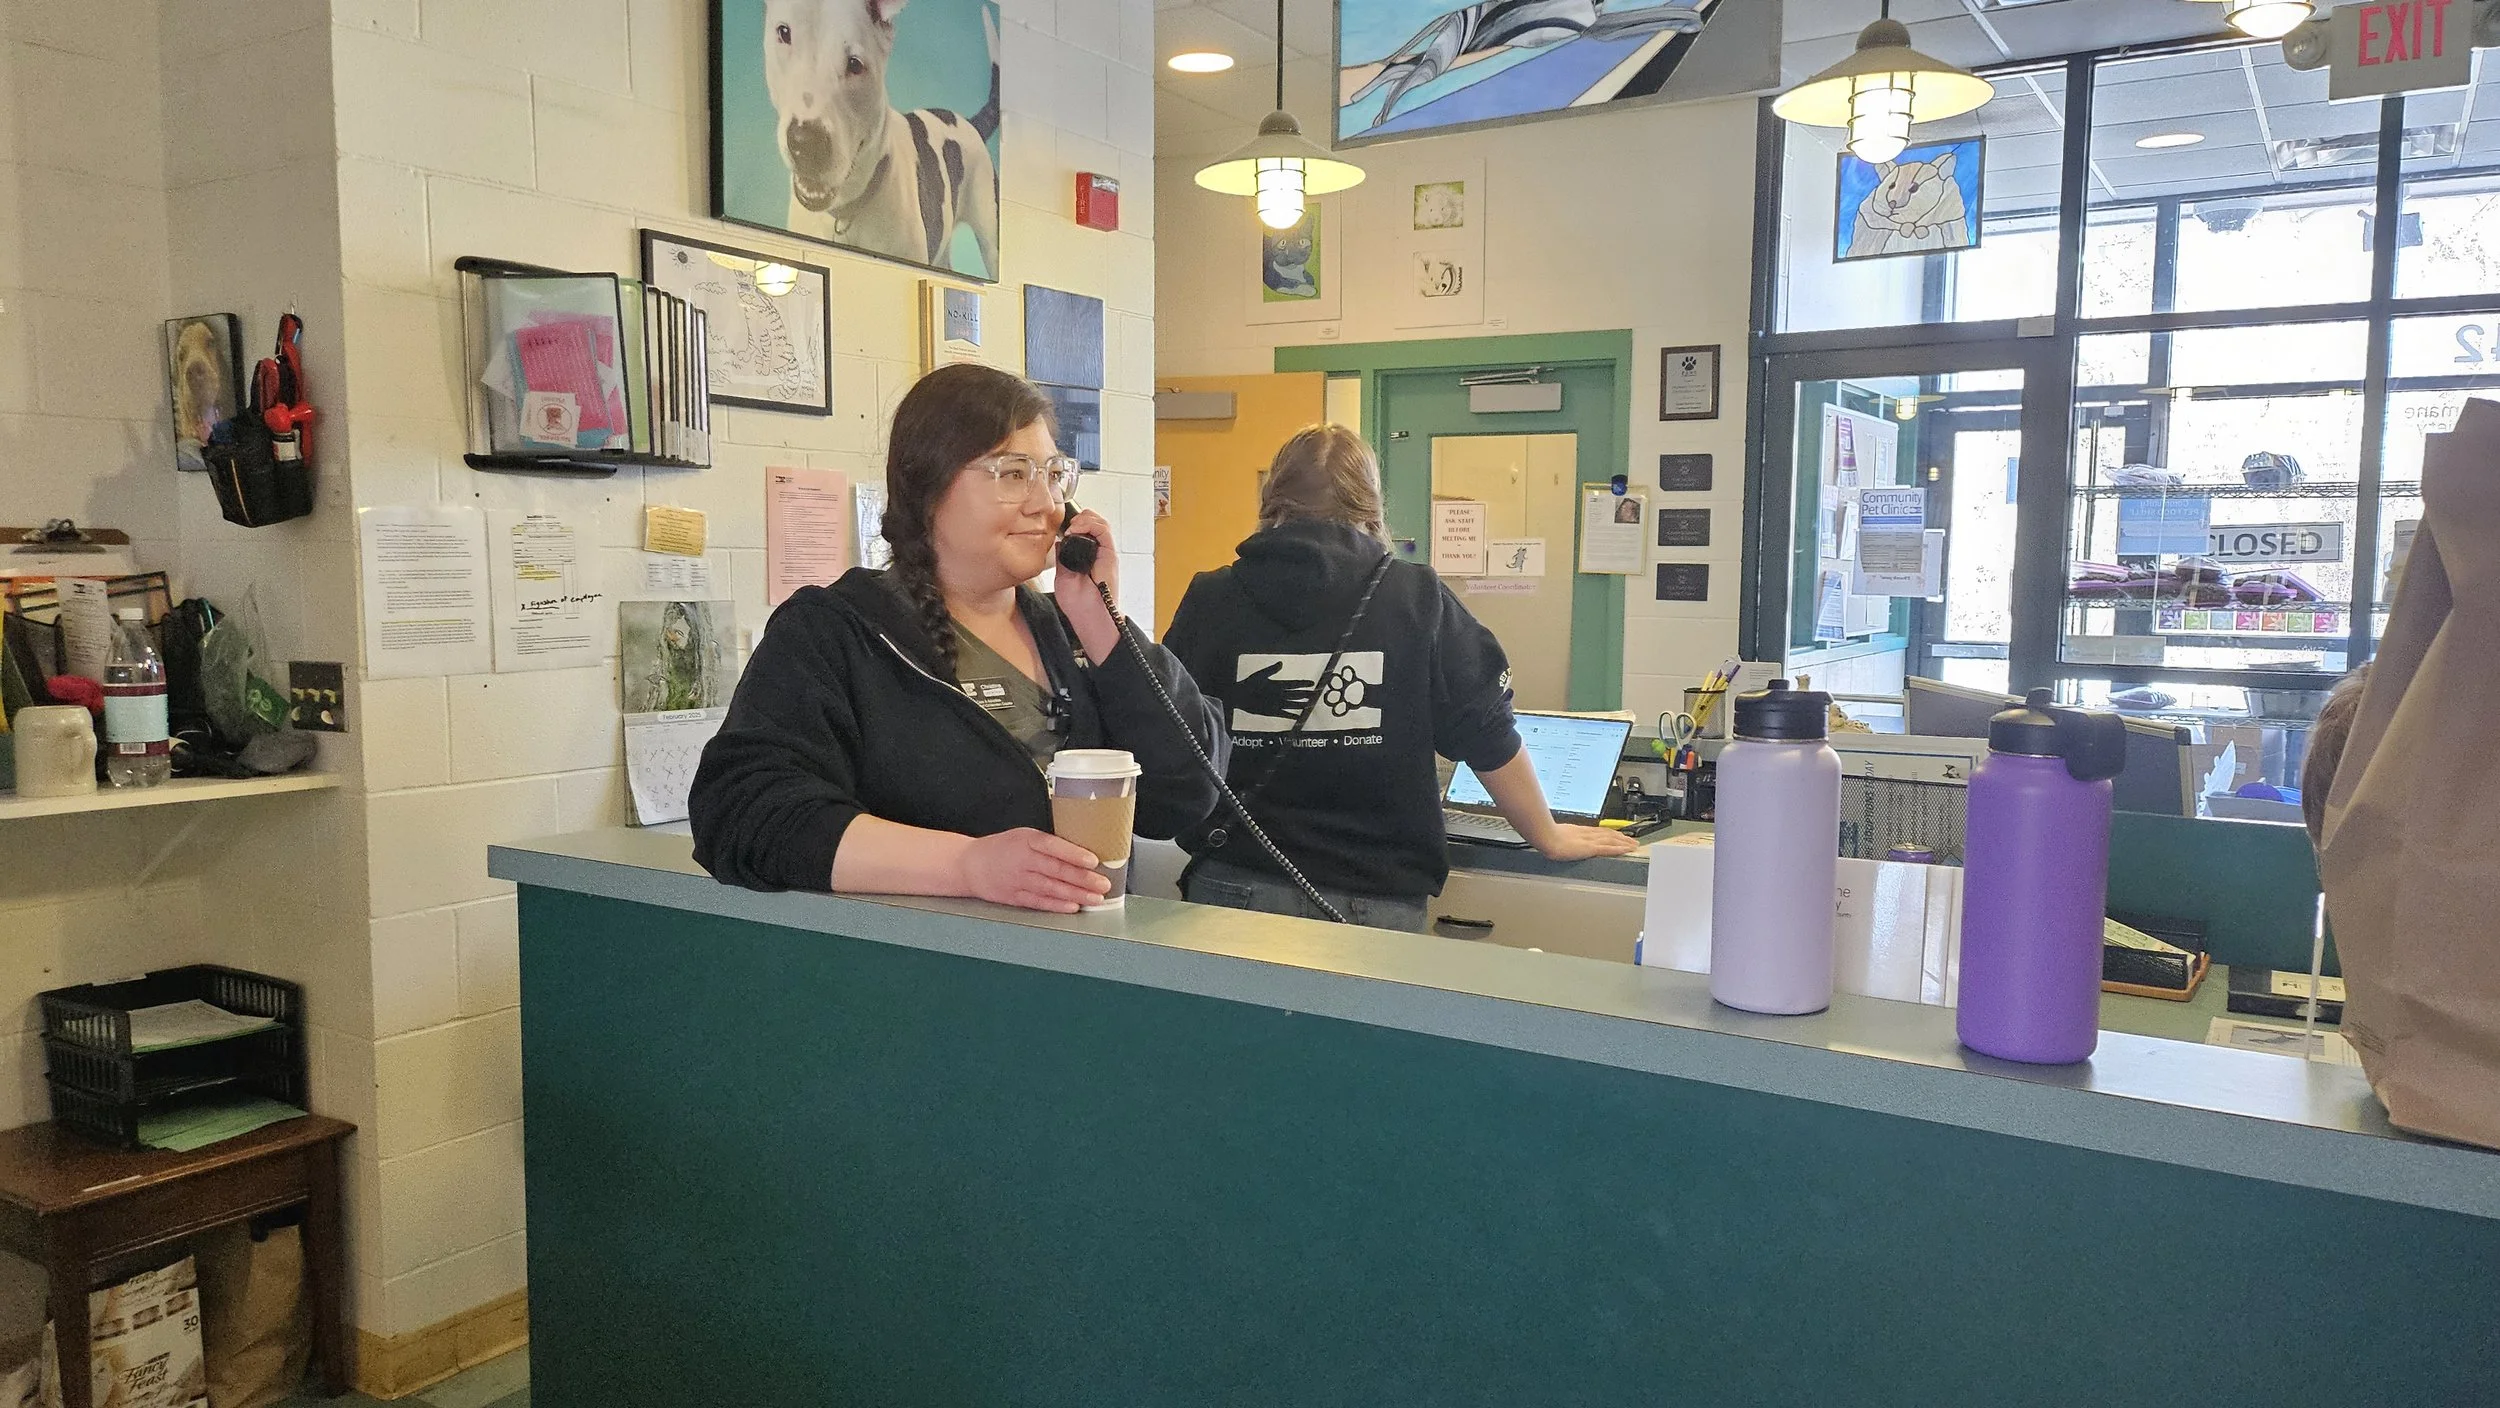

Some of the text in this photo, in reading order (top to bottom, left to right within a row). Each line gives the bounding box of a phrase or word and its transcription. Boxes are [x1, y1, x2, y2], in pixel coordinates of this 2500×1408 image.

[2358, 0, 2453, 67] EXIT
[947, 307, 978, 322] NO-KILL
[1862, 491, 1922, 505] Community
[1862, 503, 1909, 515] Pet Clinic
[1231, 734, 1383, 748] Adopt Vlunteer Donate
[184, 1315, 199, 1330] 30
